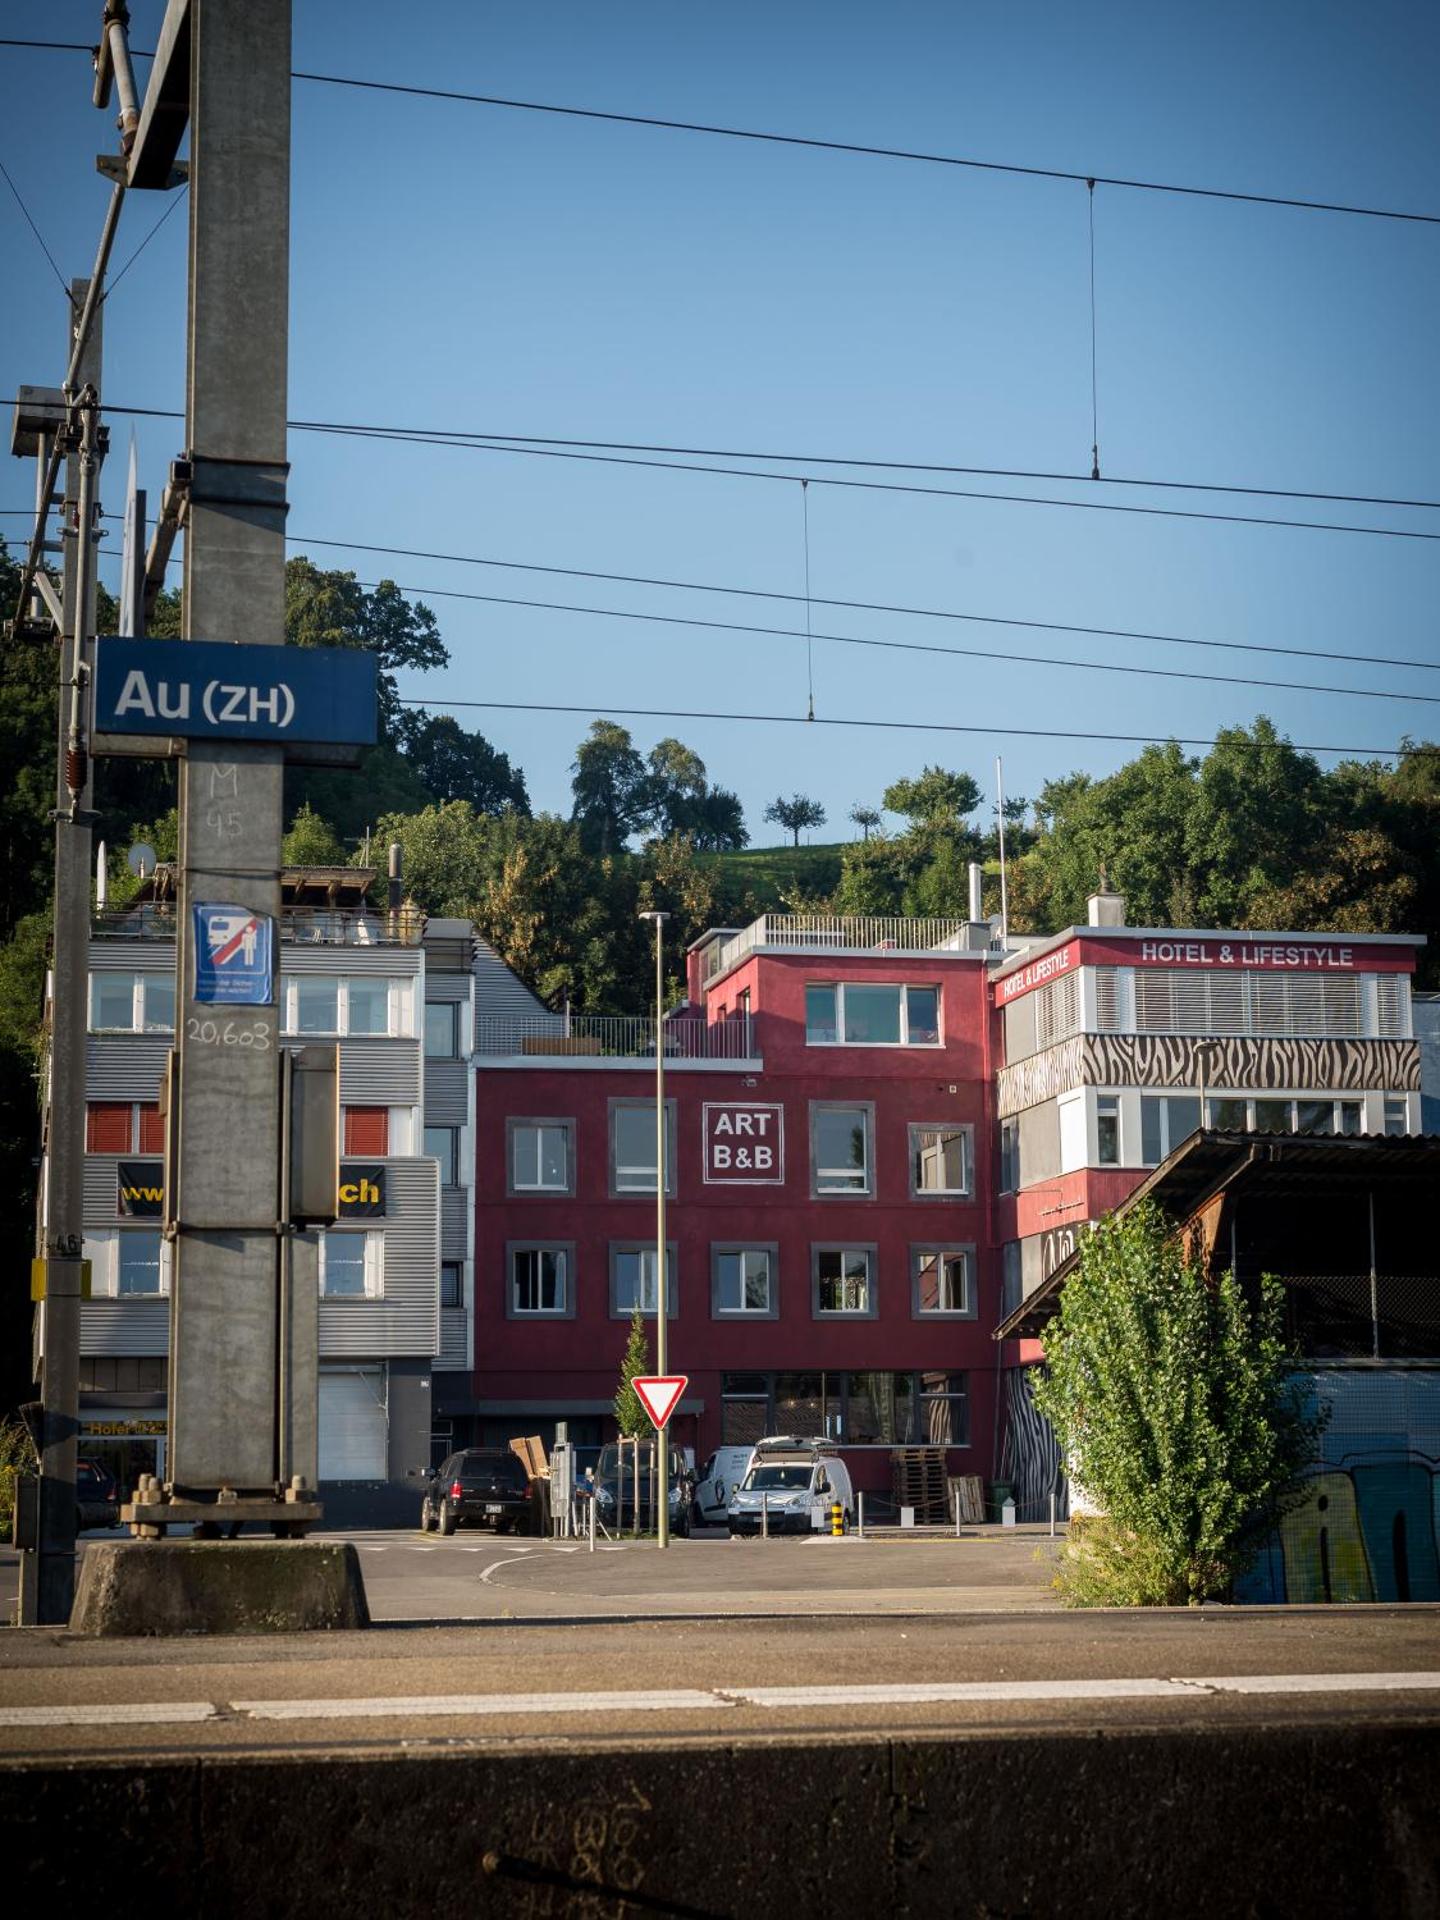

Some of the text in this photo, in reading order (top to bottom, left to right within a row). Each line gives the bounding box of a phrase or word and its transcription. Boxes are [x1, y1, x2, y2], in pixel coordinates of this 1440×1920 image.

[114, 670, 296, 727] Au (ZH)
[1142, 942, 1353, 967] HOTEL & LIFESTYLE
[1004, 972, 1026, 998] HOTEL
[1032, 949, 1069, 984] LIFESTYLE
[713, 1113, 771, 1135] ART
[713, 1145, 773, 1169] B&B
